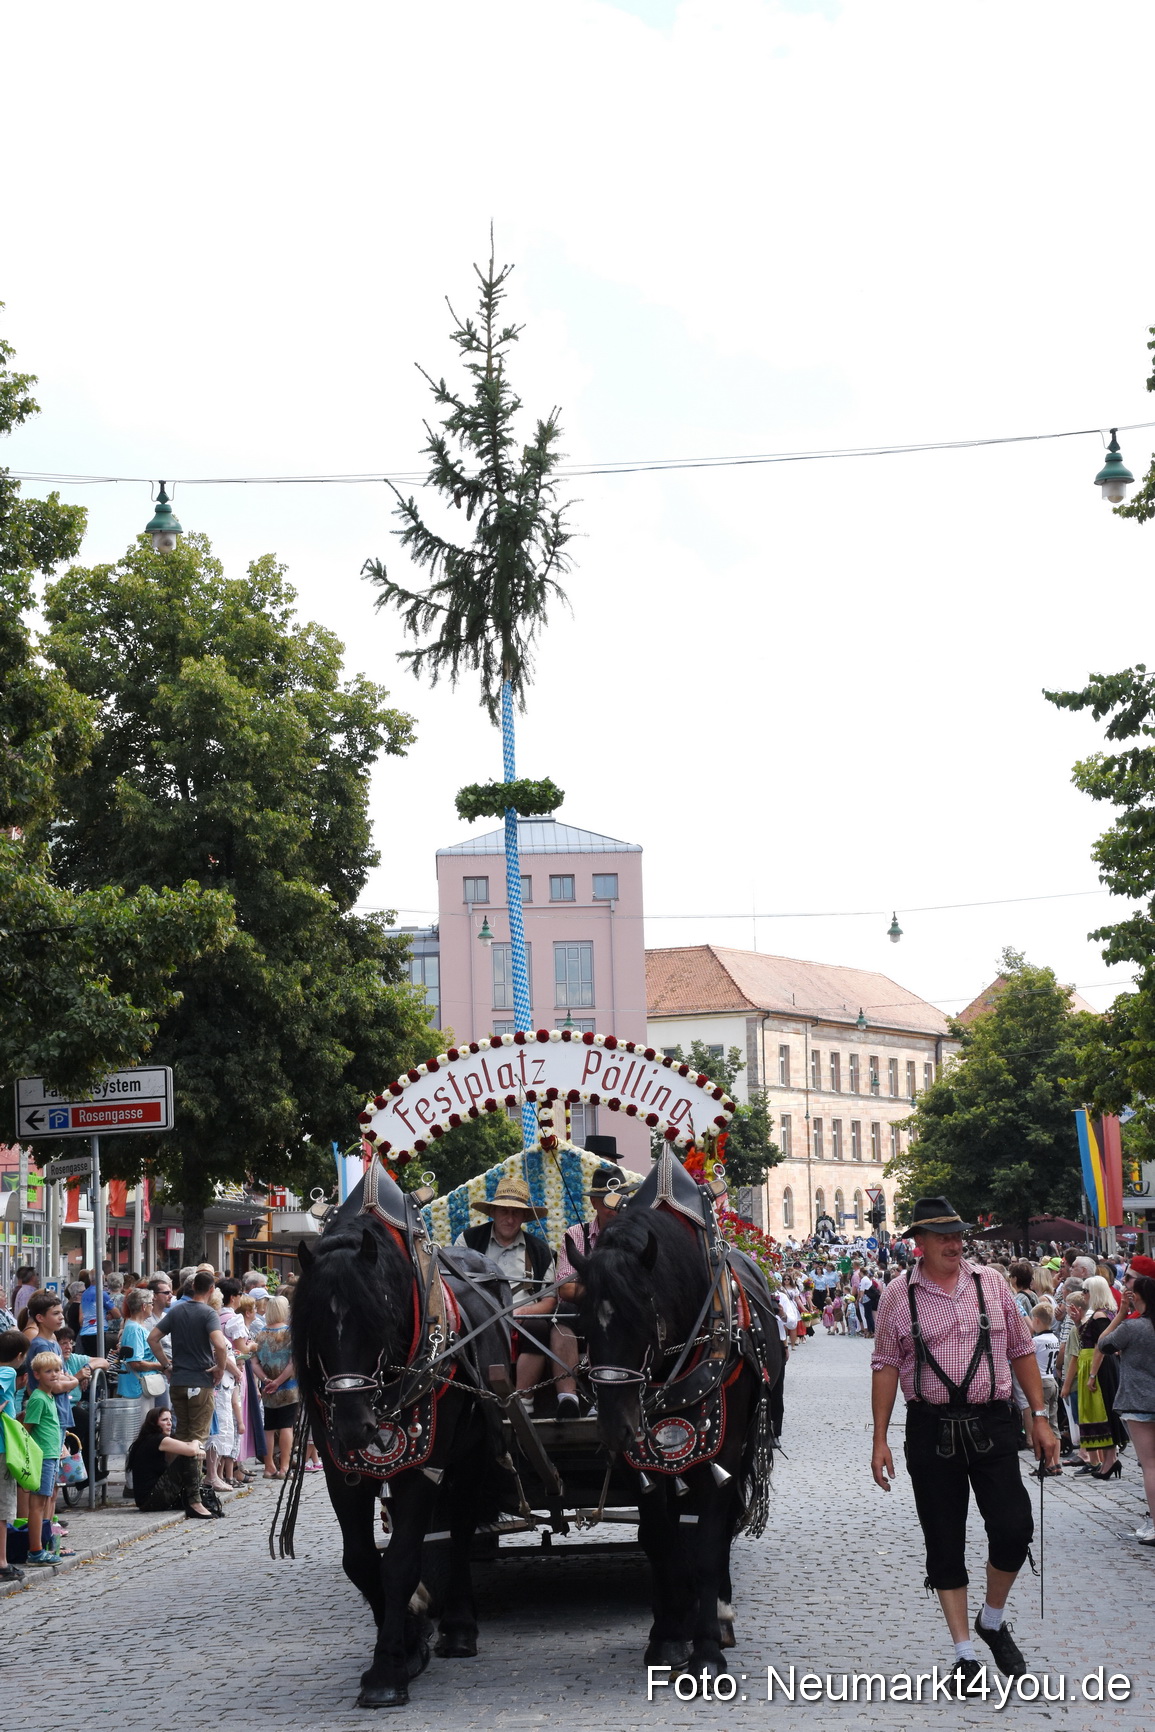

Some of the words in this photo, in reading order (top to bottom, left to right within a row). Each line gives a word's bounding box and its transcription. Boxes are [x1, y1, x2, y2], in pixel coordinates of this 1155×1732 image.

[392, 1049, 546, 1135] Festplatz
[581, 1050, 693, 1126] Pölling
[79, 1108, 143, 1124] Rosengasse
[51, 1162, 88, 1176] Rosengasse
